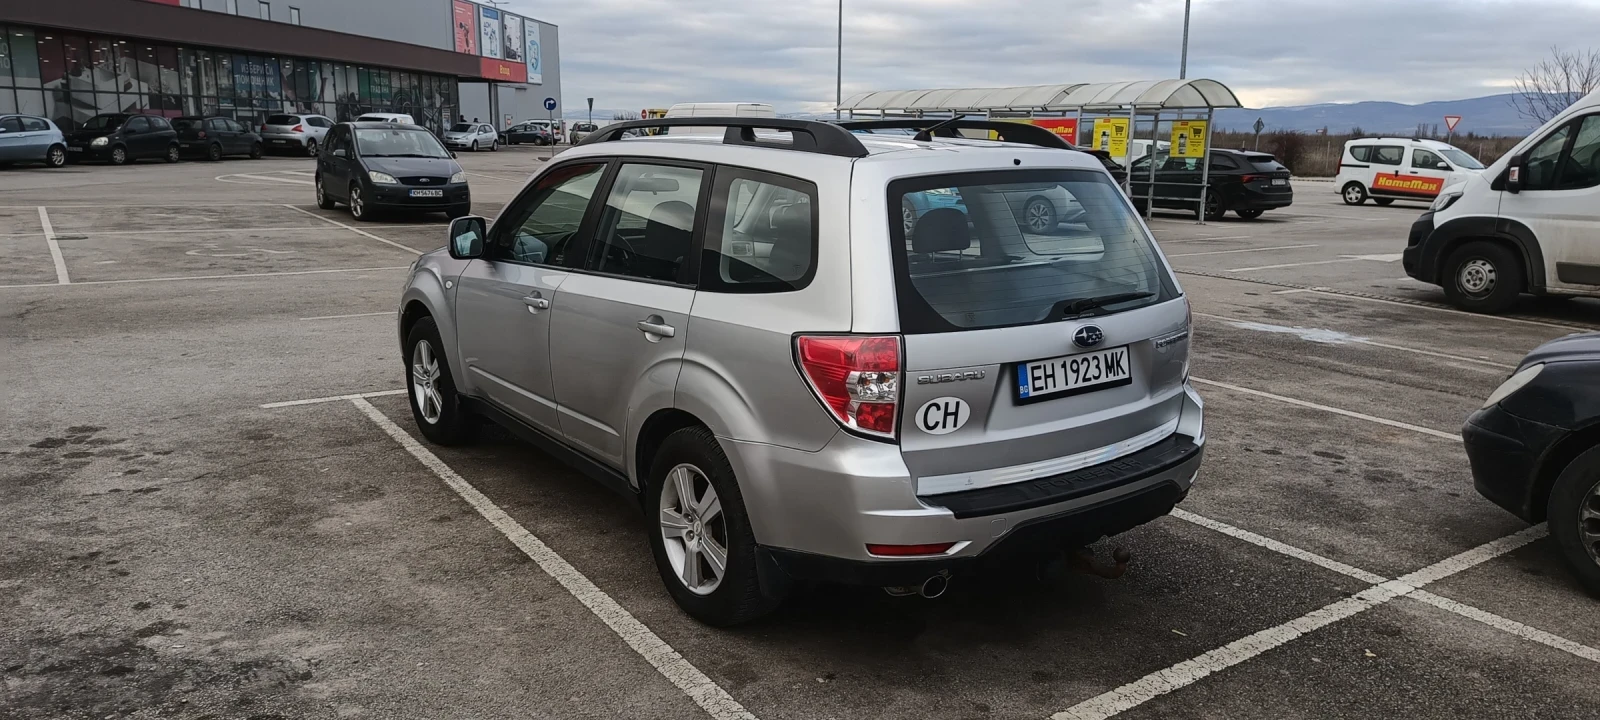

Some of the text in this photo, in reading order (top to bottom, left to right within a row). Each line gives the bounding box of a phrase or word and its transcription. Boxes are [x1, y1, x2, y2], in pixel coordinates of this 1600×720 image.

[1377, 176, 1437, 191] HomeMax
[917, 370, 985, 385] SUBARU
[1030, 350, 1126, 392] EH 1923 MK
[1019, 385, 1029, 394] BG
[923, 401, 960, 431] CH
